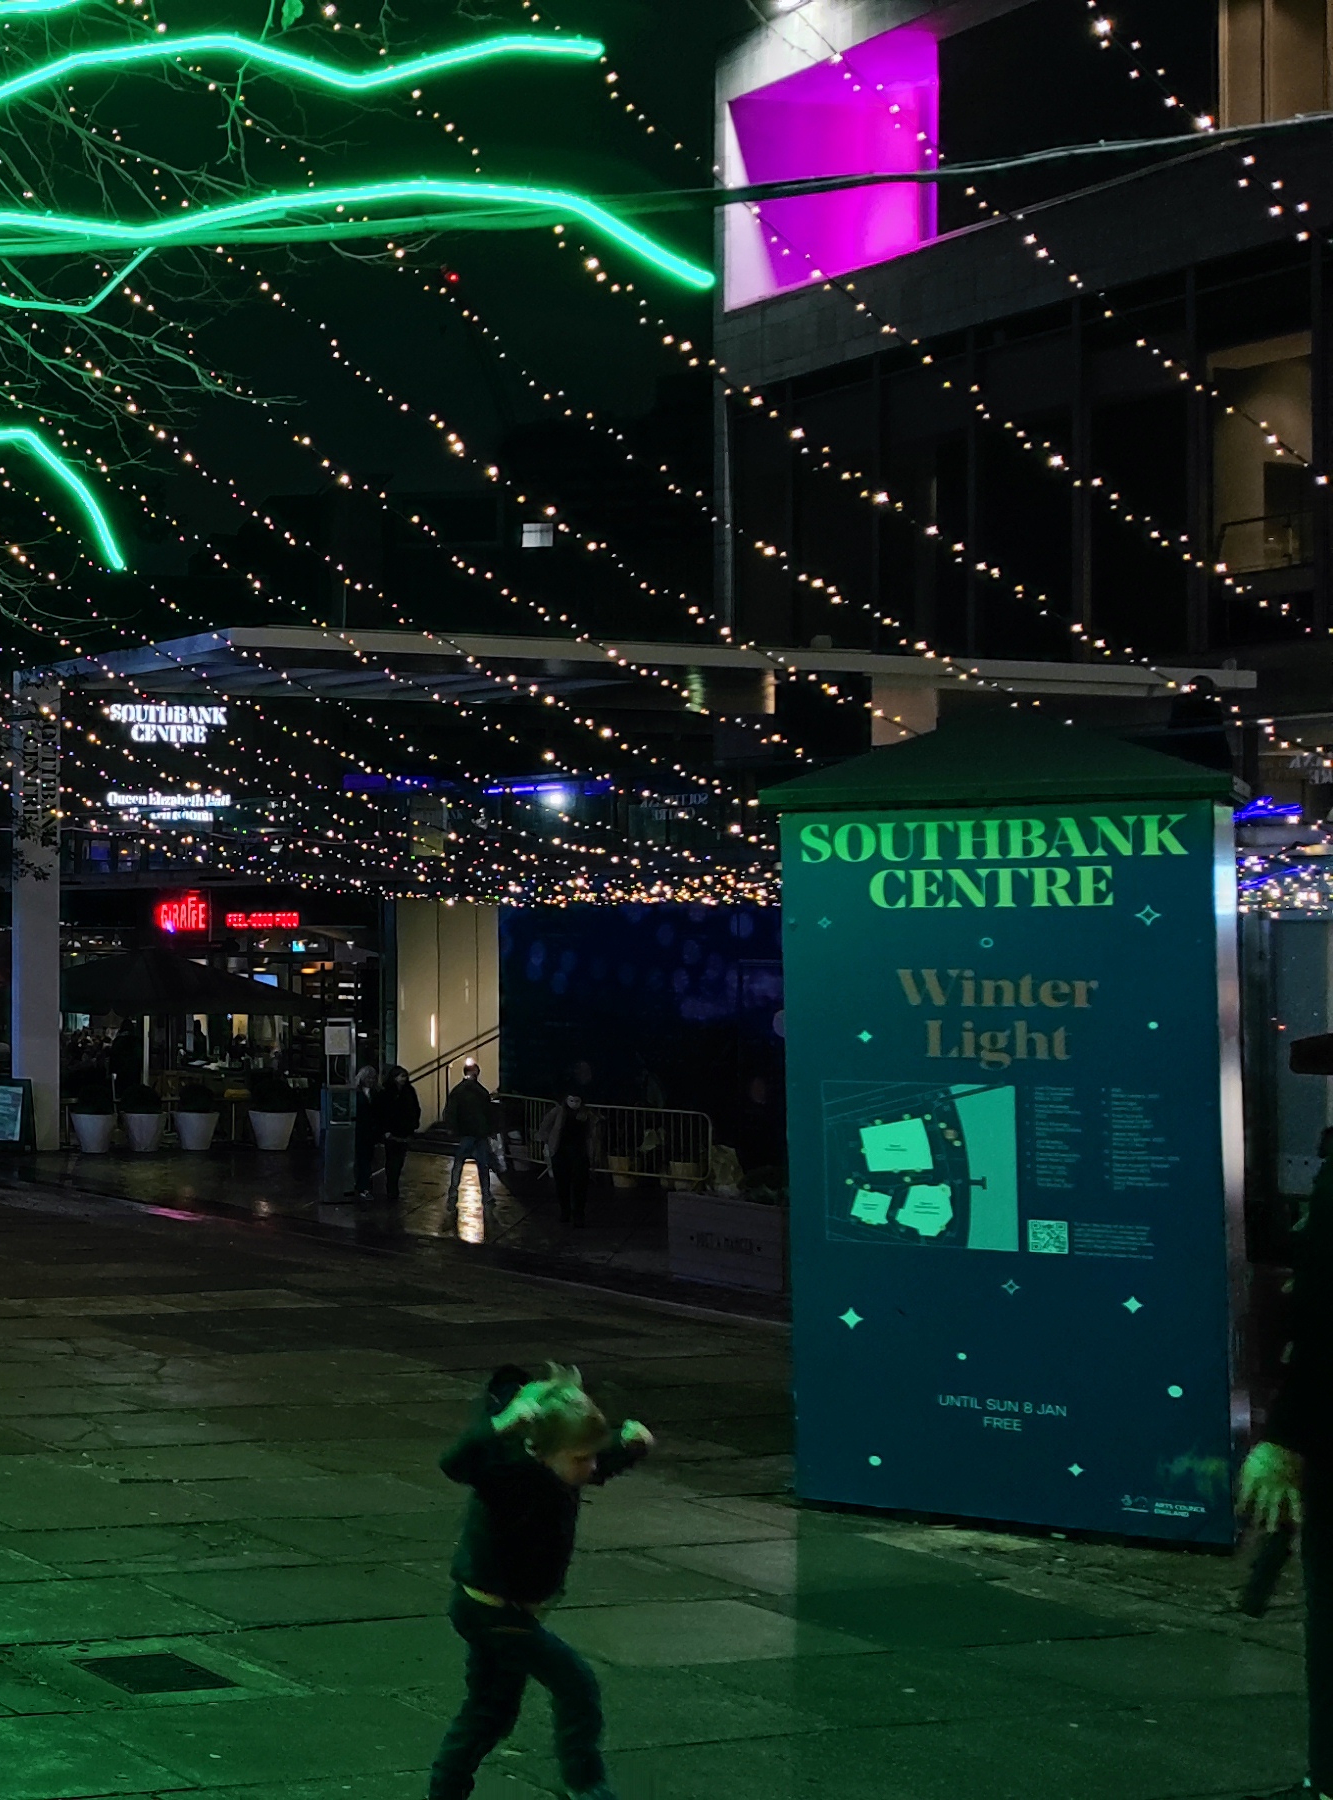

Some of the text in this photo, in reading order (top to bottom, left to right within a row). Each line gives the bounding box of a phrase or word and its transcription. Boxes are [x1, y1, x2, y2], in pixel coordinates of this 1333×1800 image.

[109, 703, 227, 725] SOUTHBANK
[131, 723, 207, 744] CENTRE
[107, 791, 147, 807] Queen
[149, 792, 204, 807] Elizabeth
[800, 812, 1188, 865] SOUTHBANK
[869, 865, 1114, 909] CENTRE
[160, 896, 206, 929] GIRAFFE
[897, 968, 1099, 1009] Winter
[925, 1018, 1072, 1070] Light
[938, 1394, 1067, 1418] UNTIL SUN 8 JAN
[983, 1416, 1023, 1431] FREE
